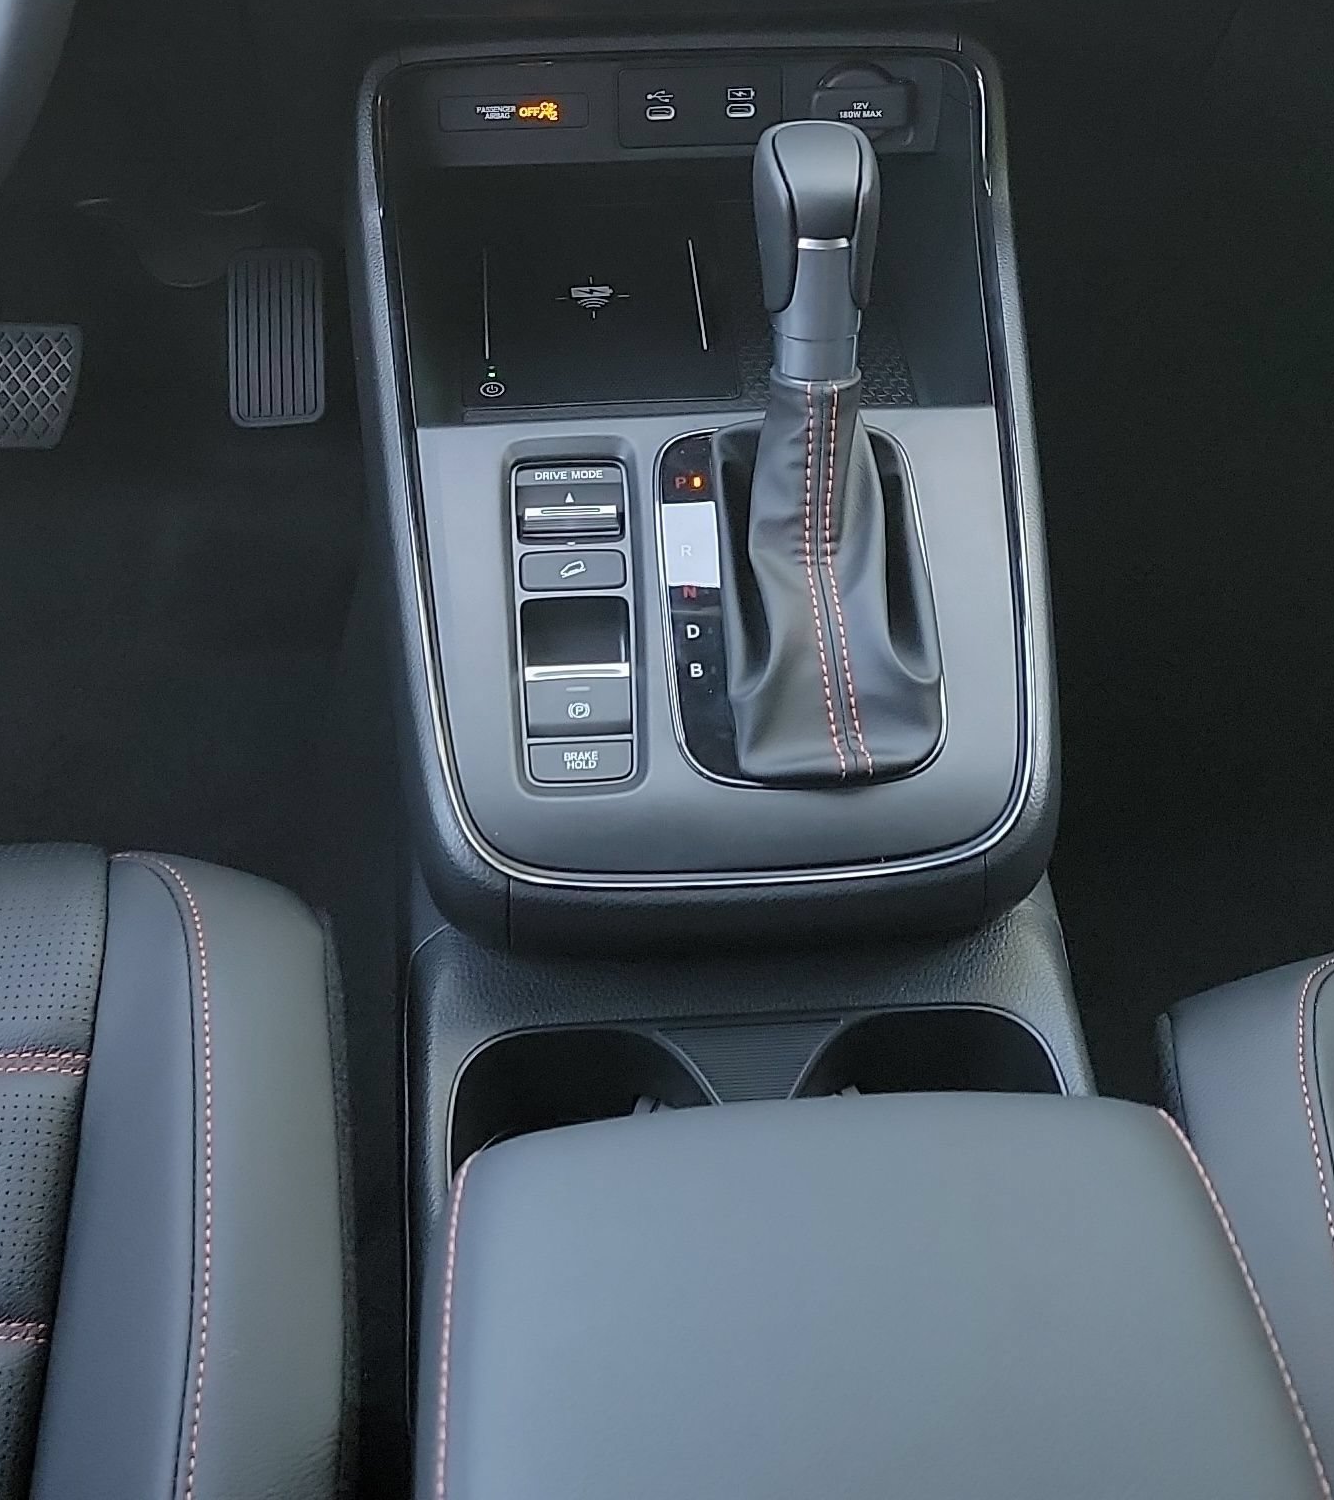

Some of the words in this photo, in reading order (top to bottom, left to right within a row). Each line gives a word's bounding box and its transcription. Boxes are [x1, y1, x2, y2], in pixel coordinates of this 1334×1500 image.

[475, 105, 517, 114] PASSENGER
[518, 106, 541, 118] OFF
[852, 101, 870, 110] 12V
[484, 112, 511, 120] AIRBAG
[862, 110, 883, 118] MAX
[534, 471, 568, 481] DRIVE
[571, 469, 604, 480] MODE
[674, 476, 687, 489] P
[680, 544, 693, 557] R
[683, 585, 698, 599] N
[686, 624, 700, 639] D
[689, 663, 704, 678] B
[563, 750, 599, 762] BRAKE
[566, 760, 597, 770] HOLD
